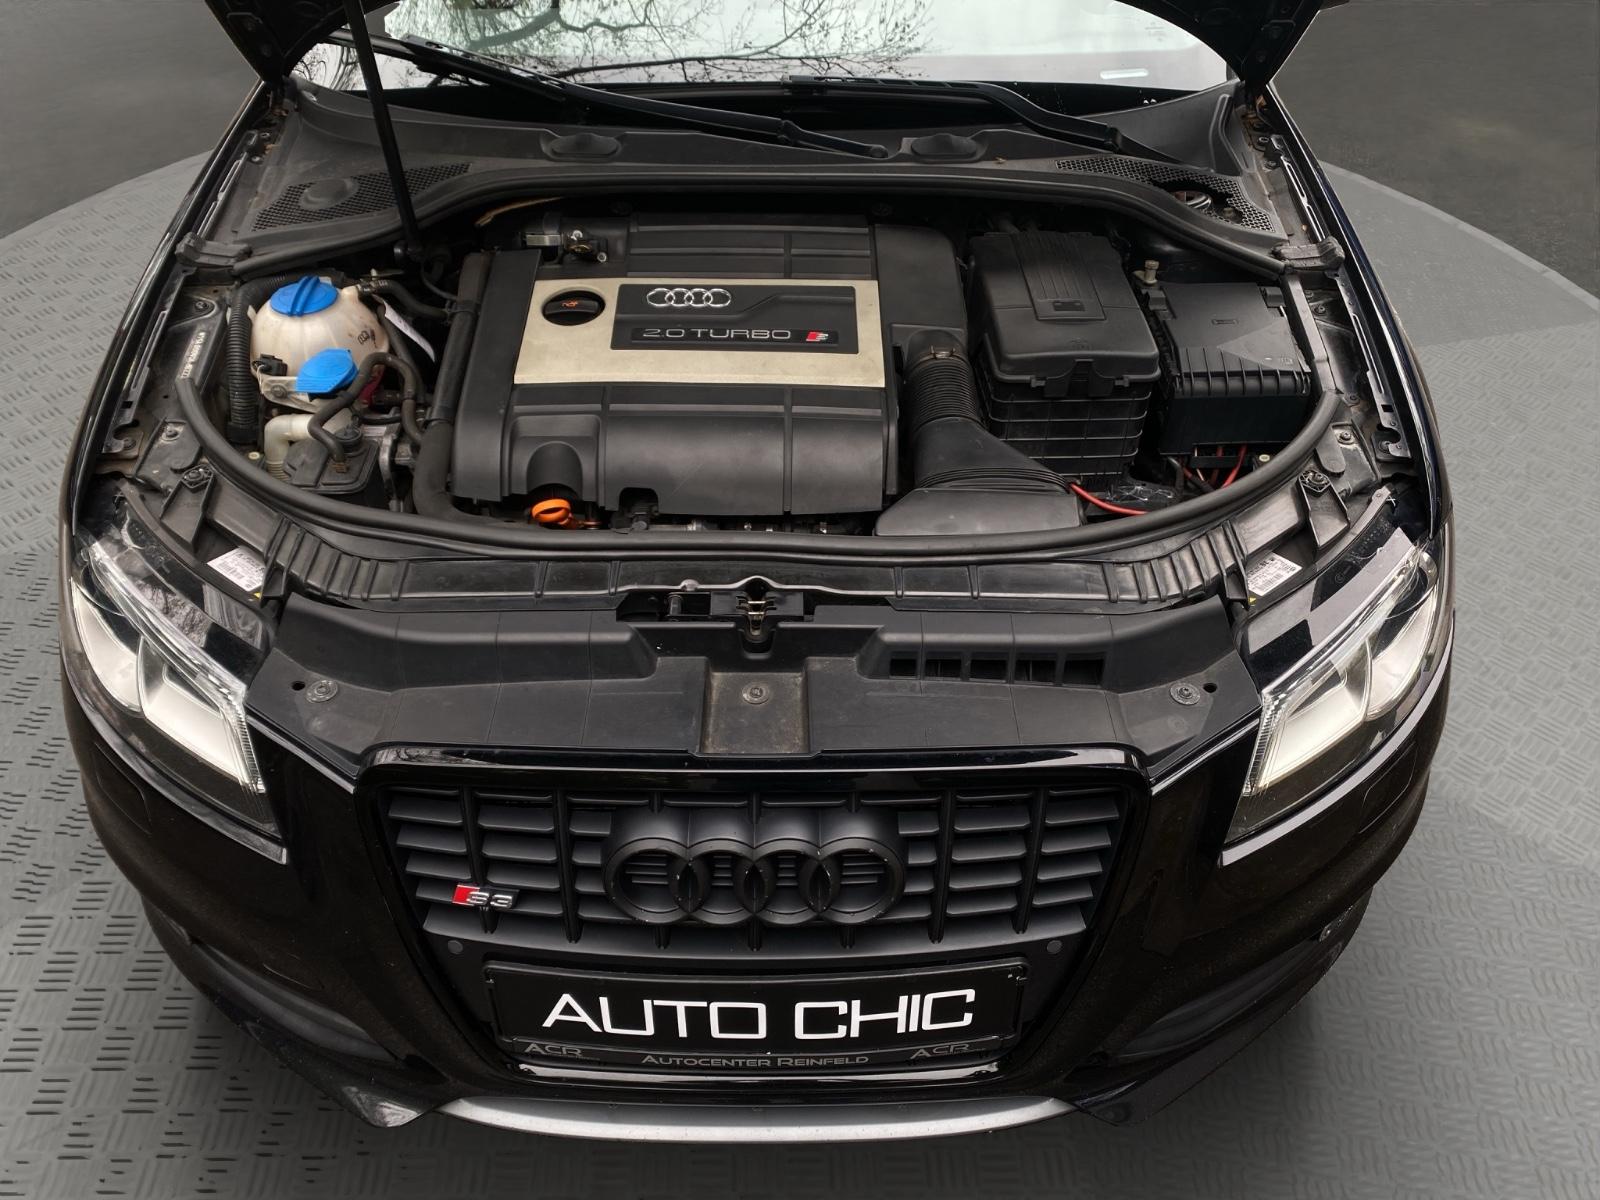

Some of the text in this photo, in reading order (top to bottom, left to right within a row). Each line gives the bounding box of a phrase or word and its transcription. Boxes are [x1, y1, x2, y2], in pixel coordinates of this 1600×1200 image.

[643, 328, 685, 338] 2.0
[690, 329, 792, 340] TURBO
[466, 891, 513, 909] S3
[542, 988, 976, 1041] AUTO CHIC
[523, 1042, 583, 1059] ACR
[909, 1042, 970, 1060] ACR
